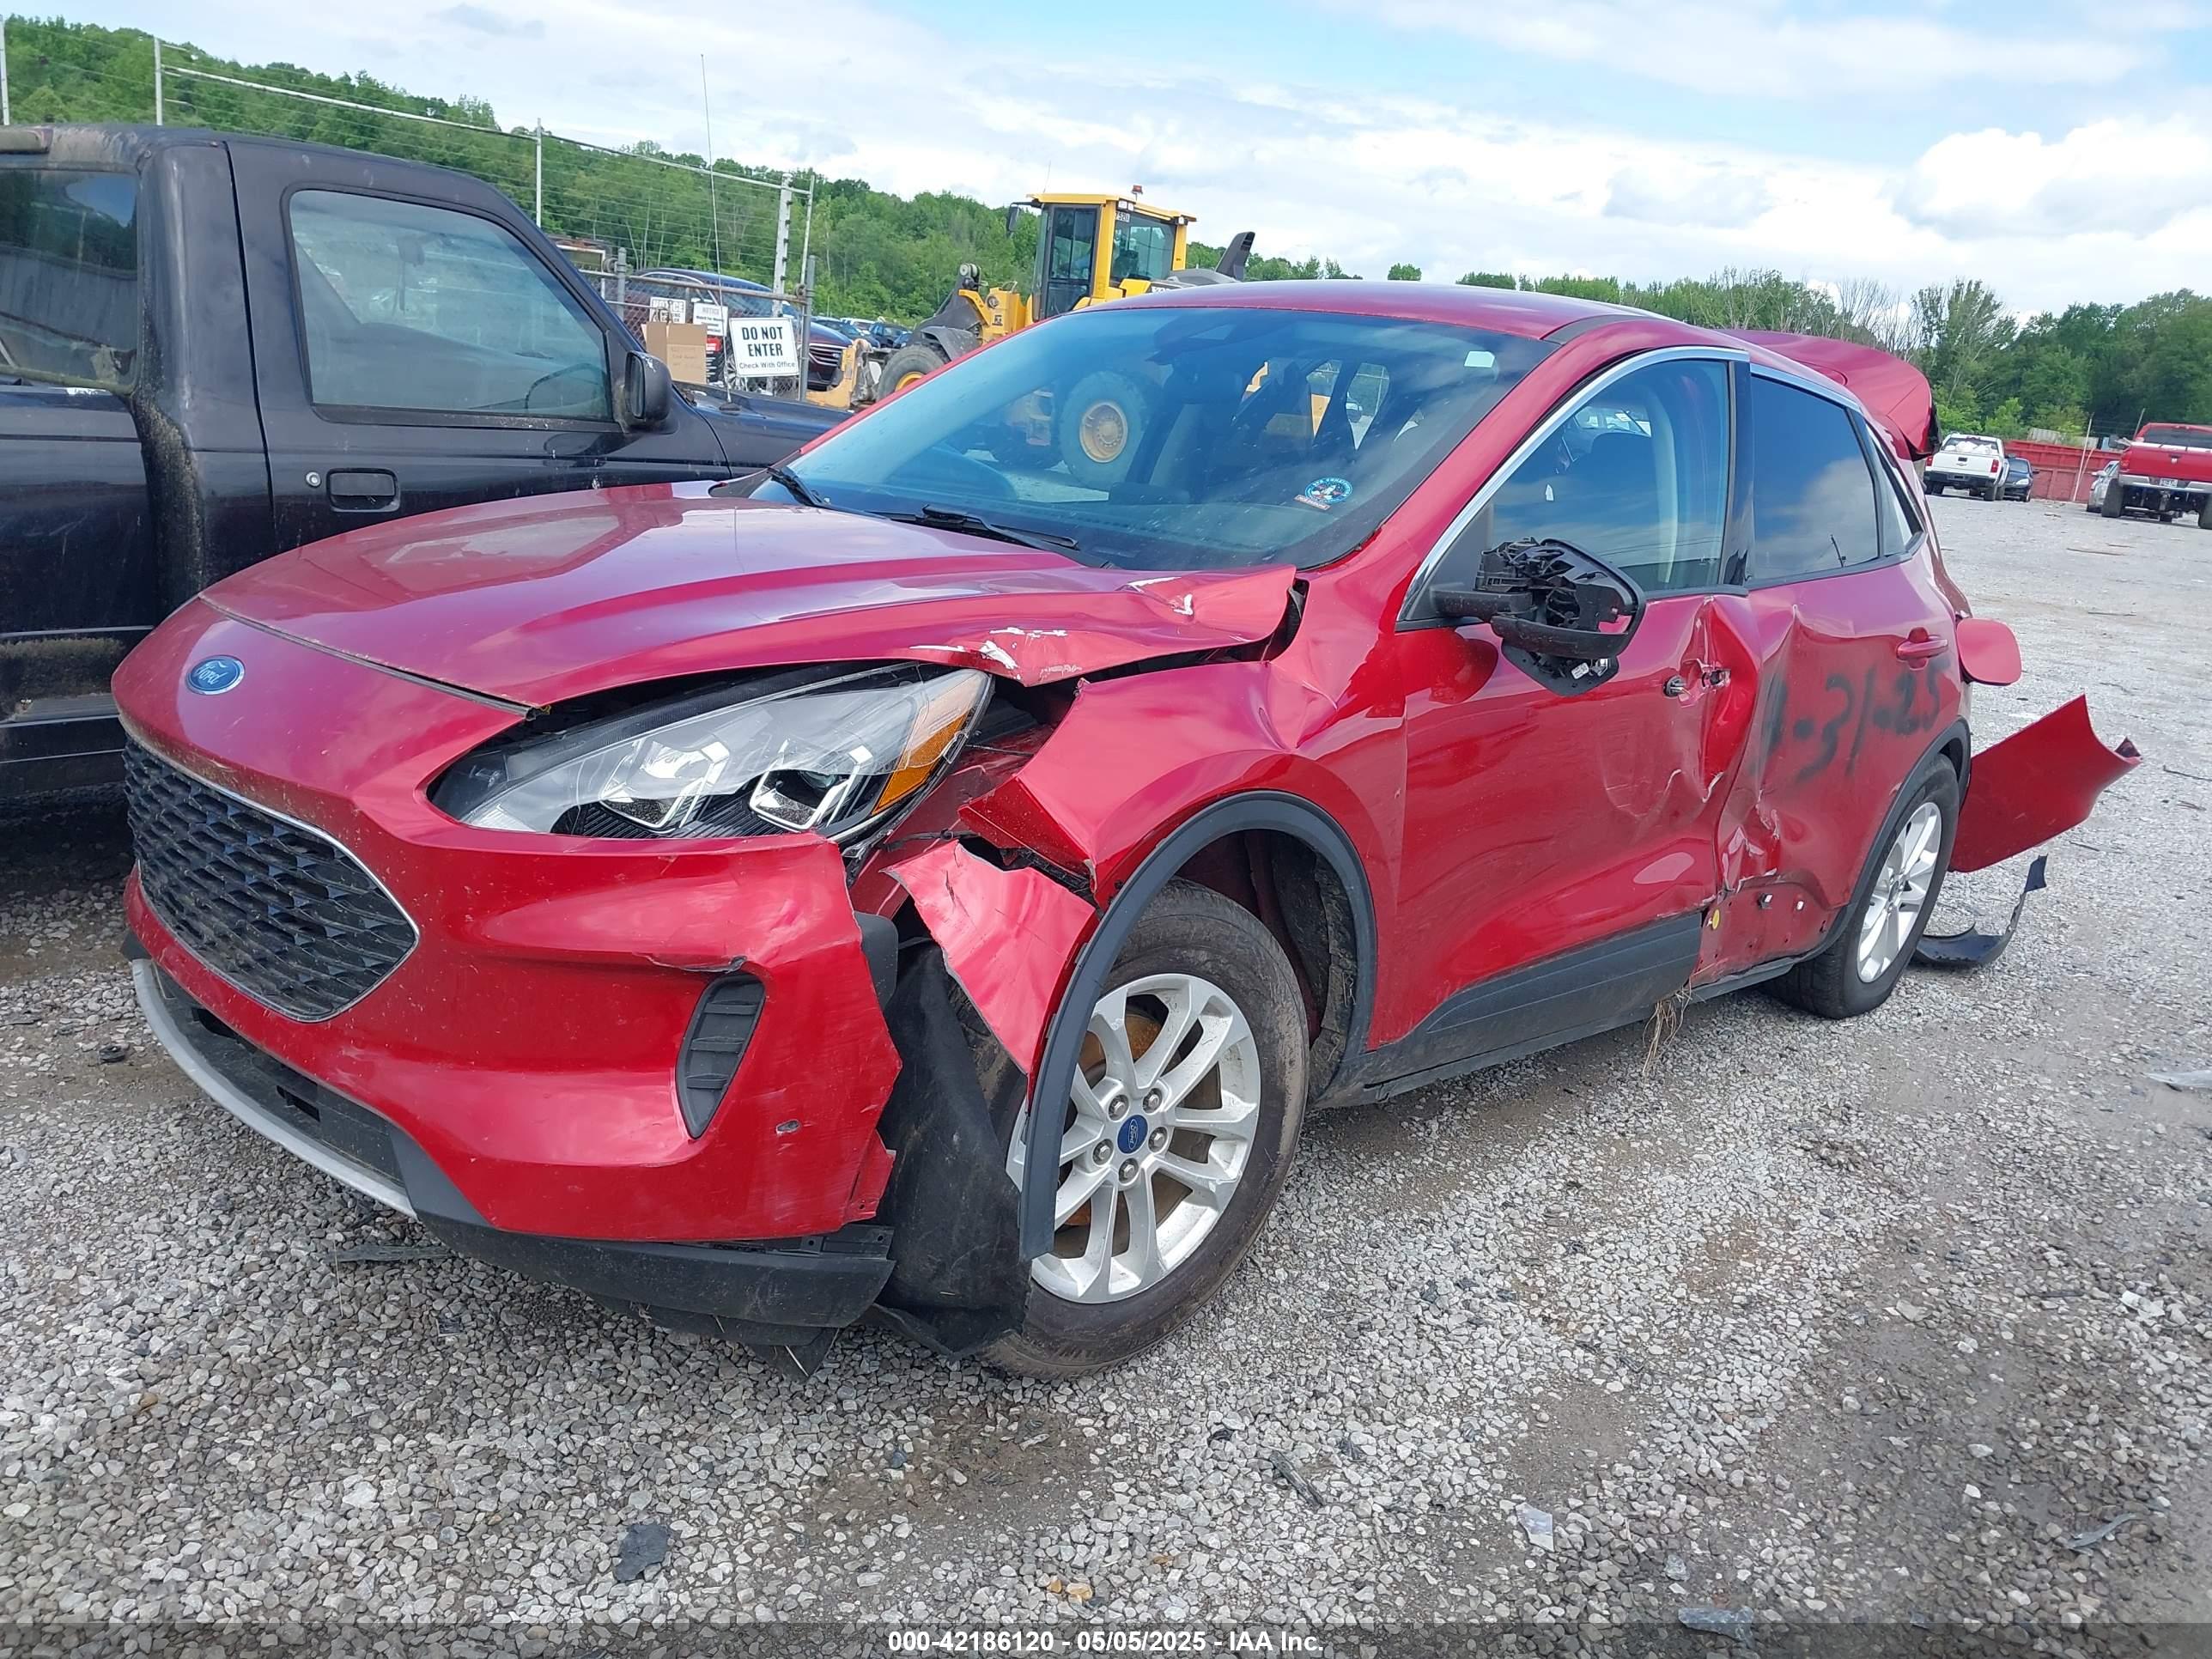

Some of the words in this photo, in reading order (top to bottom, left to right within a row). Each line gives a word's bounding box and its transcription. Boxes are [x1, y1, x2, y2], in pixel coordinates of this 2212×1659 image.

[742, 326, 757, 340] DO
[761, 326, 782, 340] NOT
[748, 343, 783, 357] ENTER
